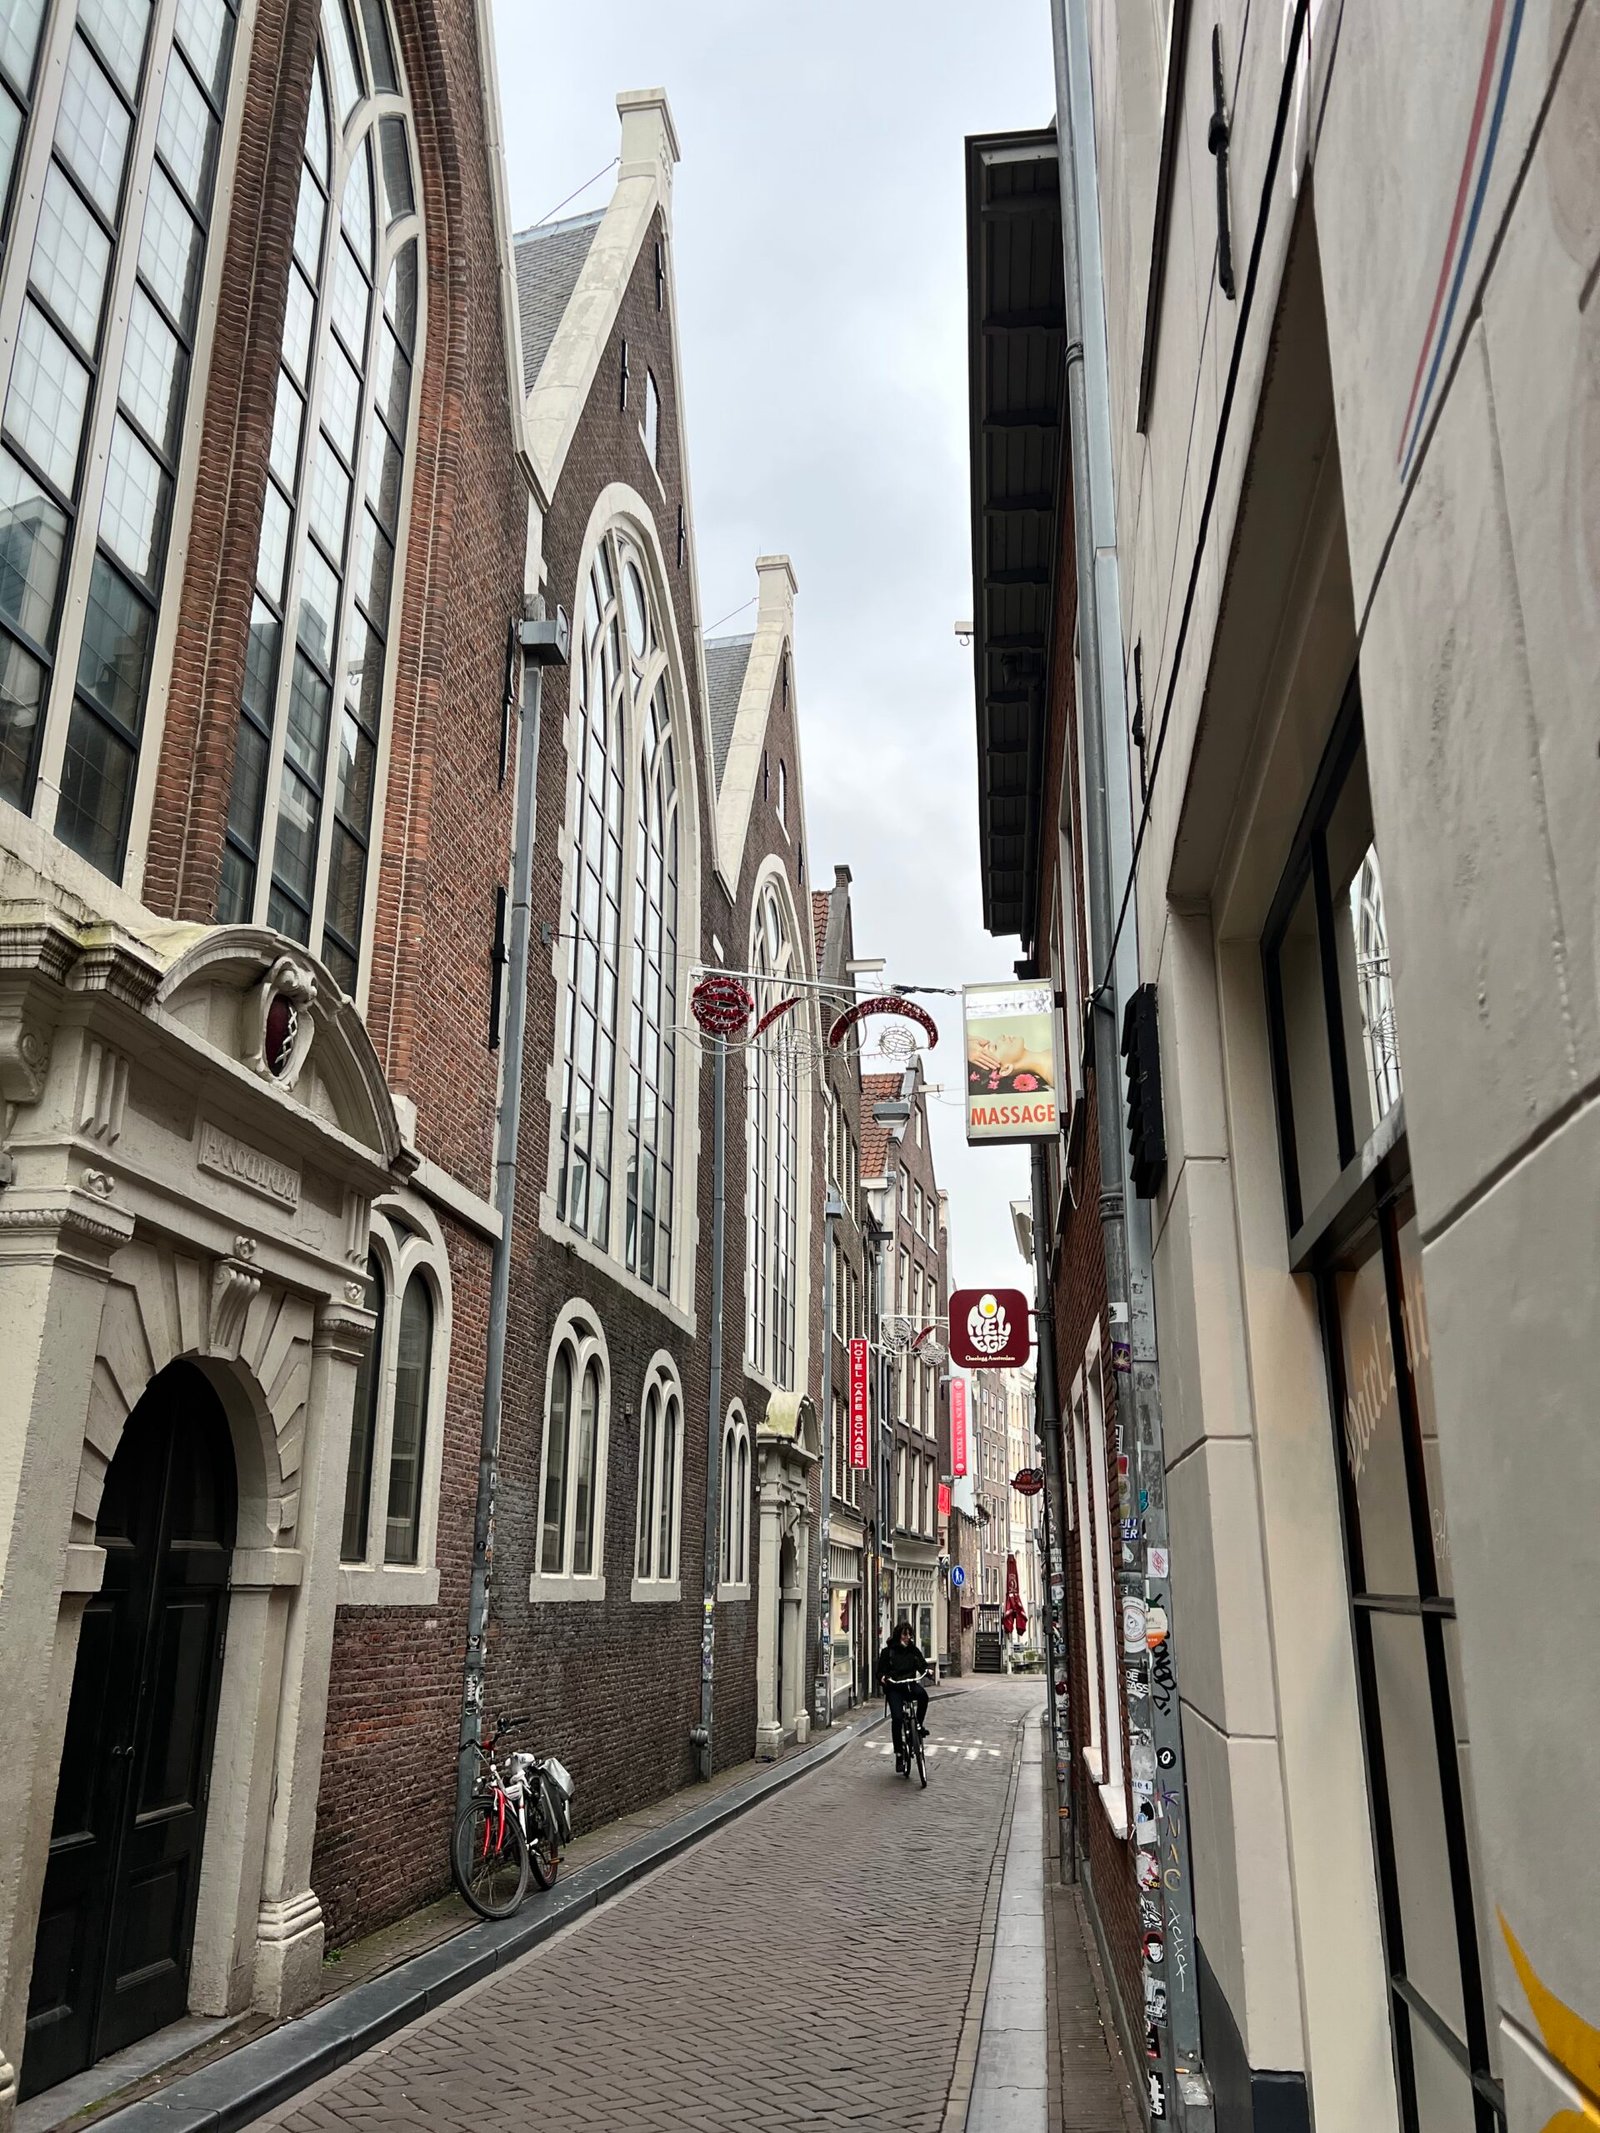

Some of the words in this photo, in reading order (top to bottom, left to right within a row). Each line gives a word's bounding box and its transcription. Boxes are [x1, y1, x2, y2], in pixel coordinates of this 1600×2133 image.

[971, 1104, 1056, 1126] MASSAGE
[853, 1342, 864, 1378] HOTEL
[853, 1382, 864, 1410] CAFE
[853, 1414, 864, 1465] SCHAGEN
